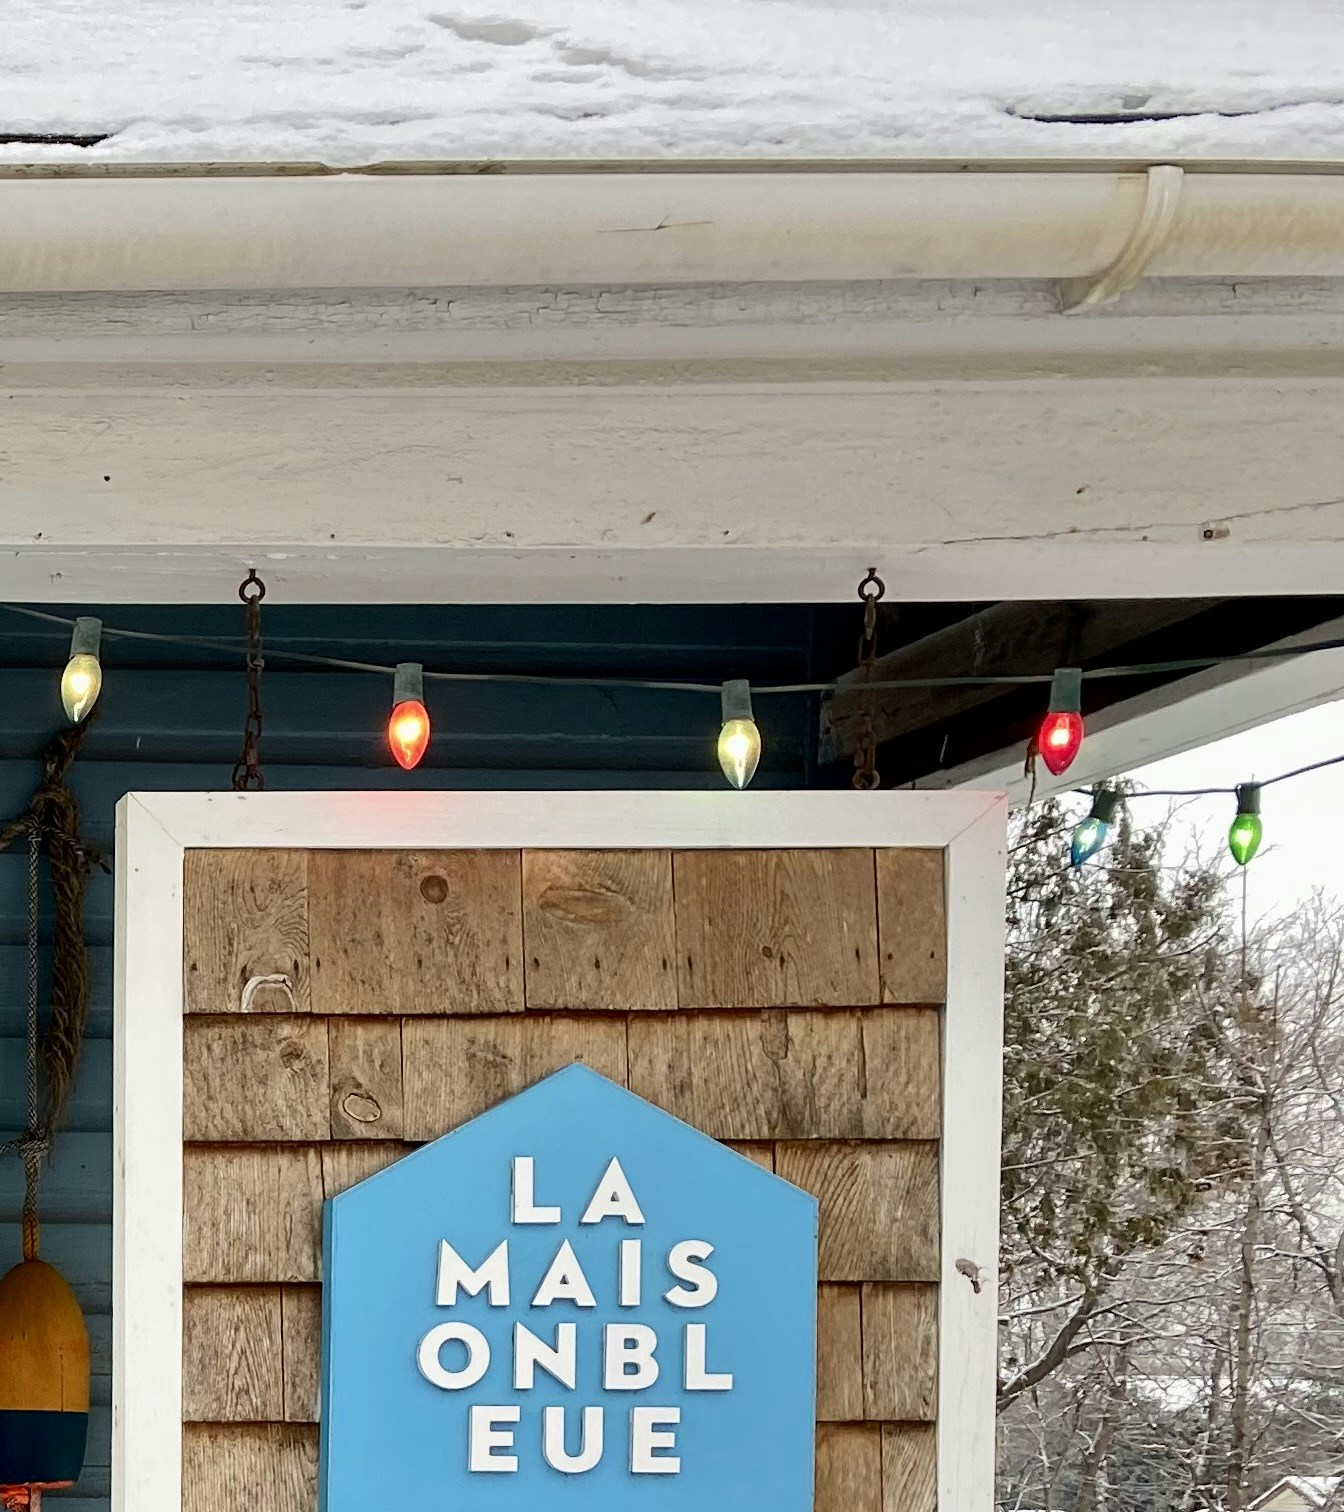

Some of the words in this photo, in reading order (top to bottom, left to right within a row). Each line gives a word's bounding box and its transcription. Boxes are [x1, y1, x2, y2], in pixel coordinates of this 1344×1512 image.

[511, 1156, 646, 1224] LA
[436, 1238, 717, 1307] MAIS
[417, 1321, 734, 1390] ONBL
[468, 1405, 681, 1473] EUE
